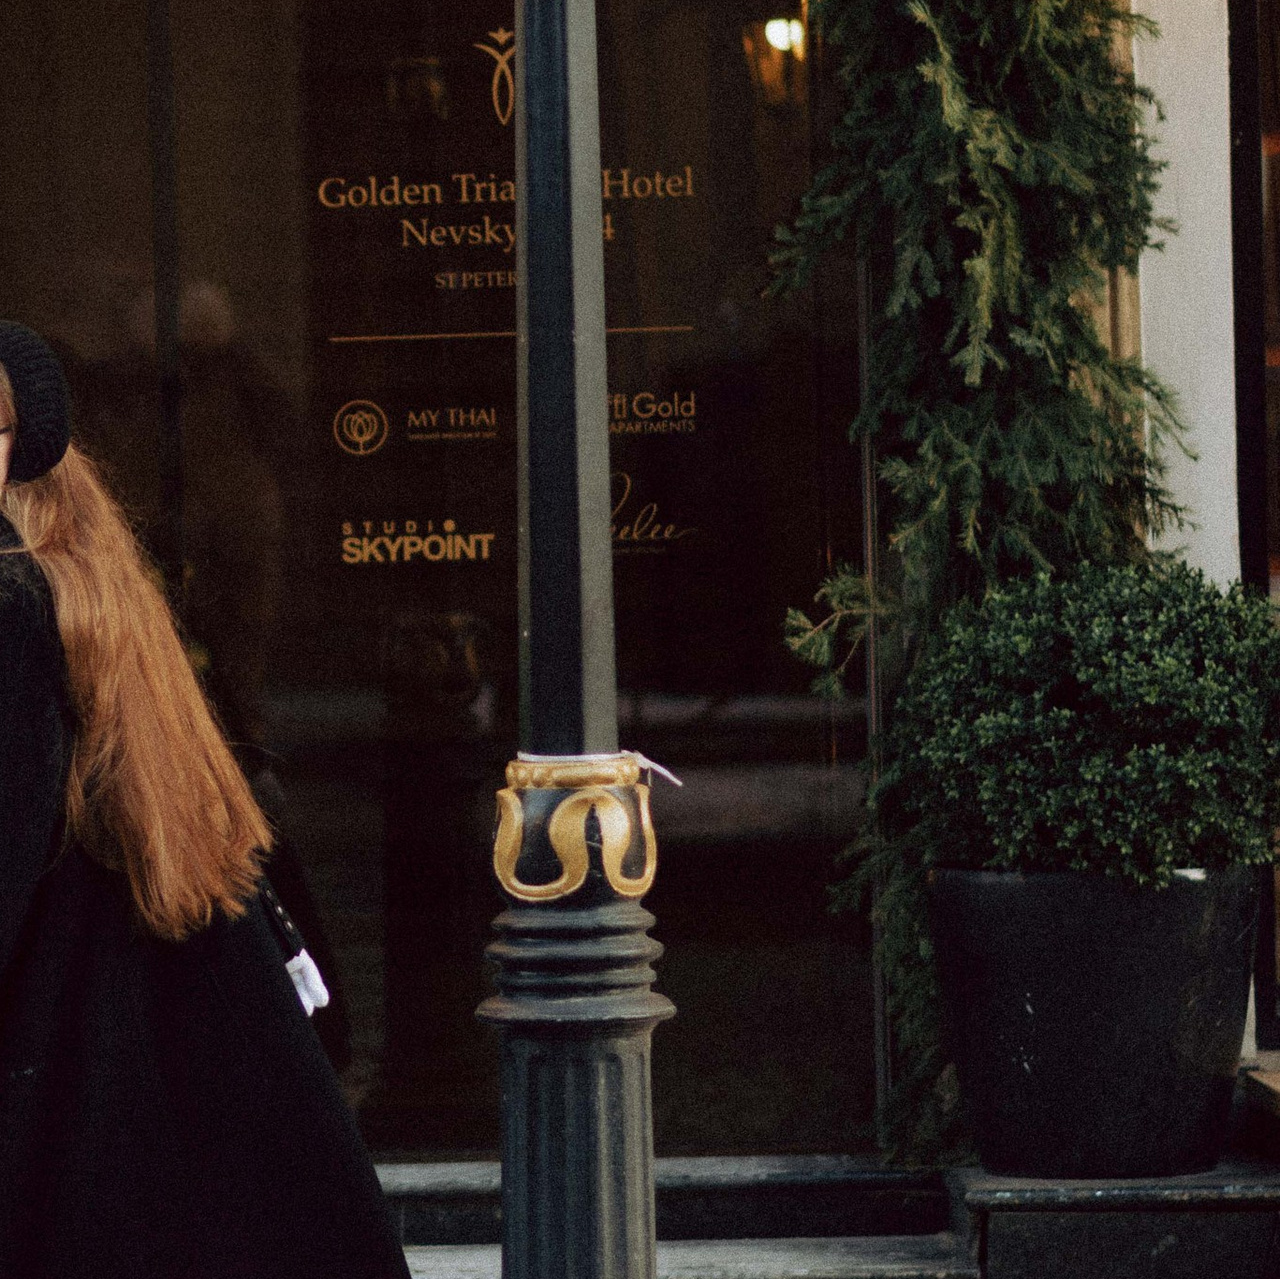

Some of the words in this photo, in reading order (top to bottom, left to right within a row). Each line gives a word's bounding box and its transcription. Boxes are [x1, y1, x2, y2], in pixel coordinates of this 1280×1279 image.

[318, 175, 443, 208] Golden
[452, 173, 516, 204] Tria
[601, 165, 695, 199] Hotel
[401, 216, 517, 253] Nevsky
[435, 272, 457, 289] ST
[461, 271, 518, 288] PETER
[407, 408, 440, 428] MY
[447, 407, 497, 428] THAI
[632, 391, 696, 419] Gold
[609, 419, 696, 434] APARTMENTS
[341, 532, 496, 565] SKYPOINT
